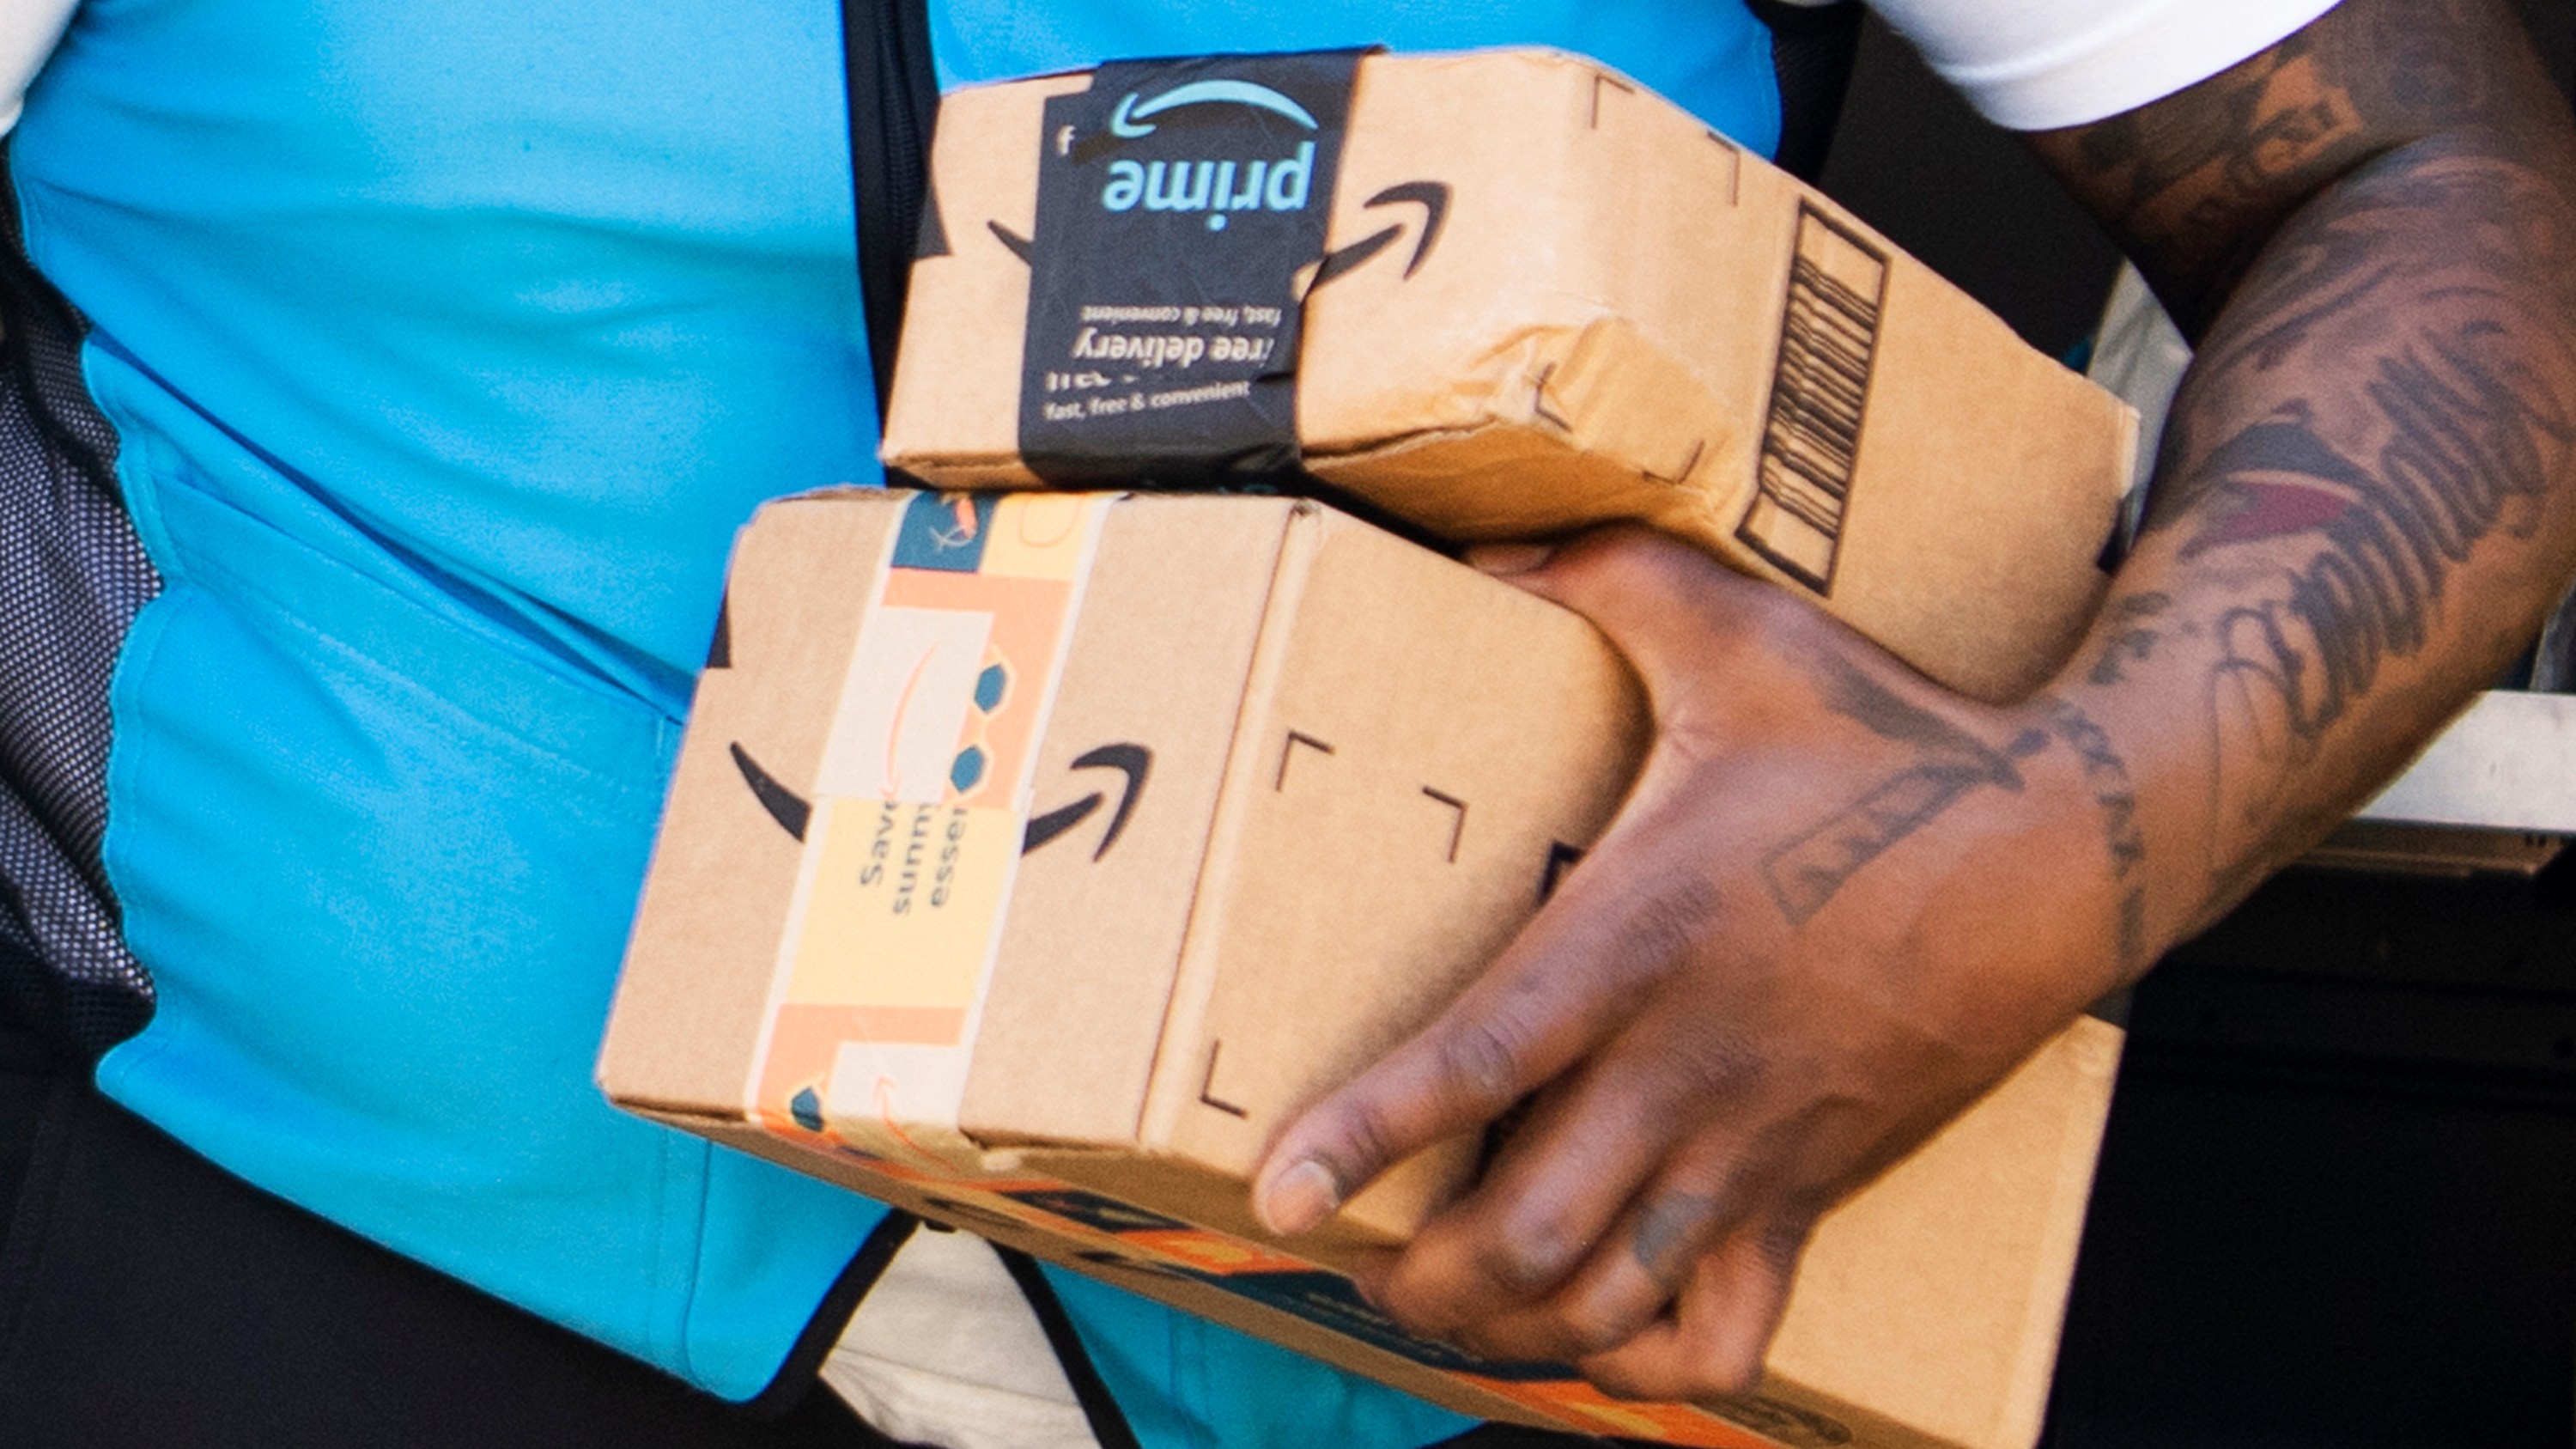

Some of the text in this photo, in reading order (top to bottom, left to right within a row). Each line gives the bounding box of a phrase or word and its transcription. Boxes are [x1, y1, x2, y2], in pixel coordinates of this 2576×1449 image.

[1102, 140, 1316, 231] prime
[1080, 306, 1180, 324] convenient
[1202, 306, 1239, 326] free
[1073, 326, 1204, 368] delivery
[1089, 397, 1127, 415] free
[1130, 393, 1145, 411] &
[1150, 381, 1251, 408] convenient
